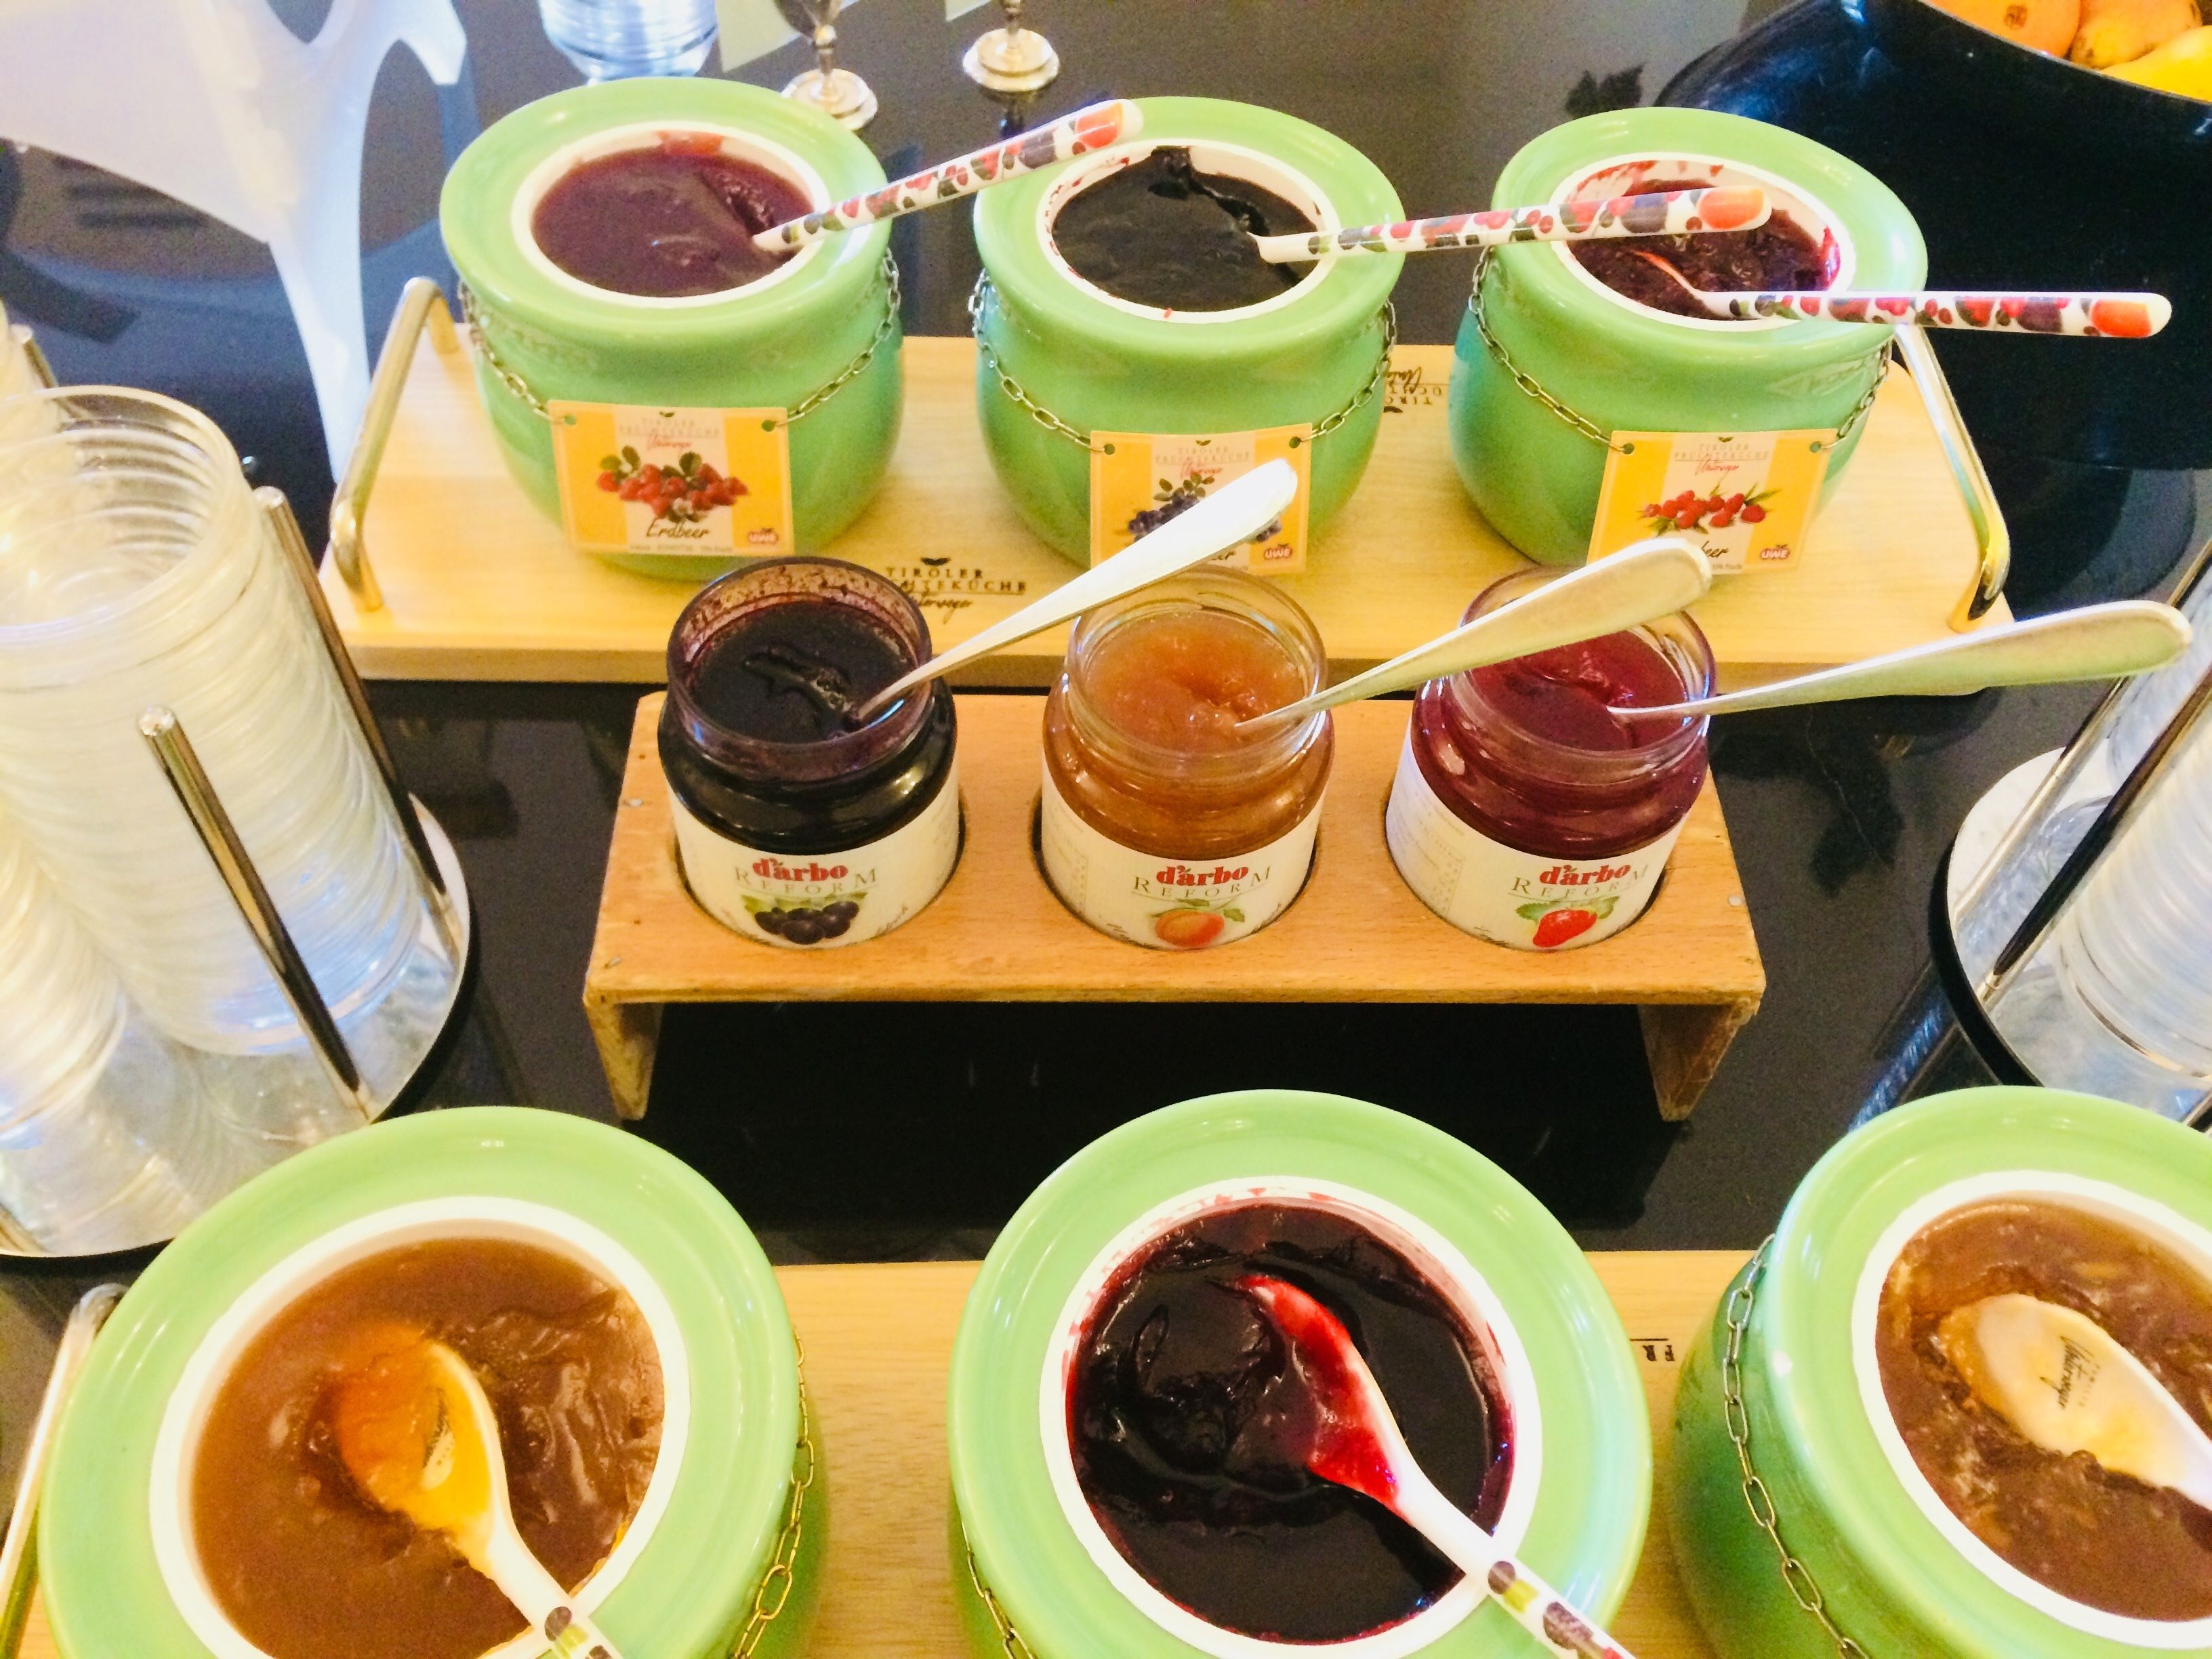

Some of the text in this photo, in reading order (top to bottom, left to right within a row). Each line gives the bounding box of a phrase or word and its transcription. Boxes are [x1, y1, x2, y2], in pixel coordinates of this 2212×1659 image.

[1698, 443, 1750, 451] TIROLER
[1700, 540, 1729, 558] beer
[885, 567, 983, 579] TIROLER
[735, 866, 879, 895] REFORM
[1134, 866, 1271, 897] REFORM
[1512, 863, 1650, 899] REFORM
